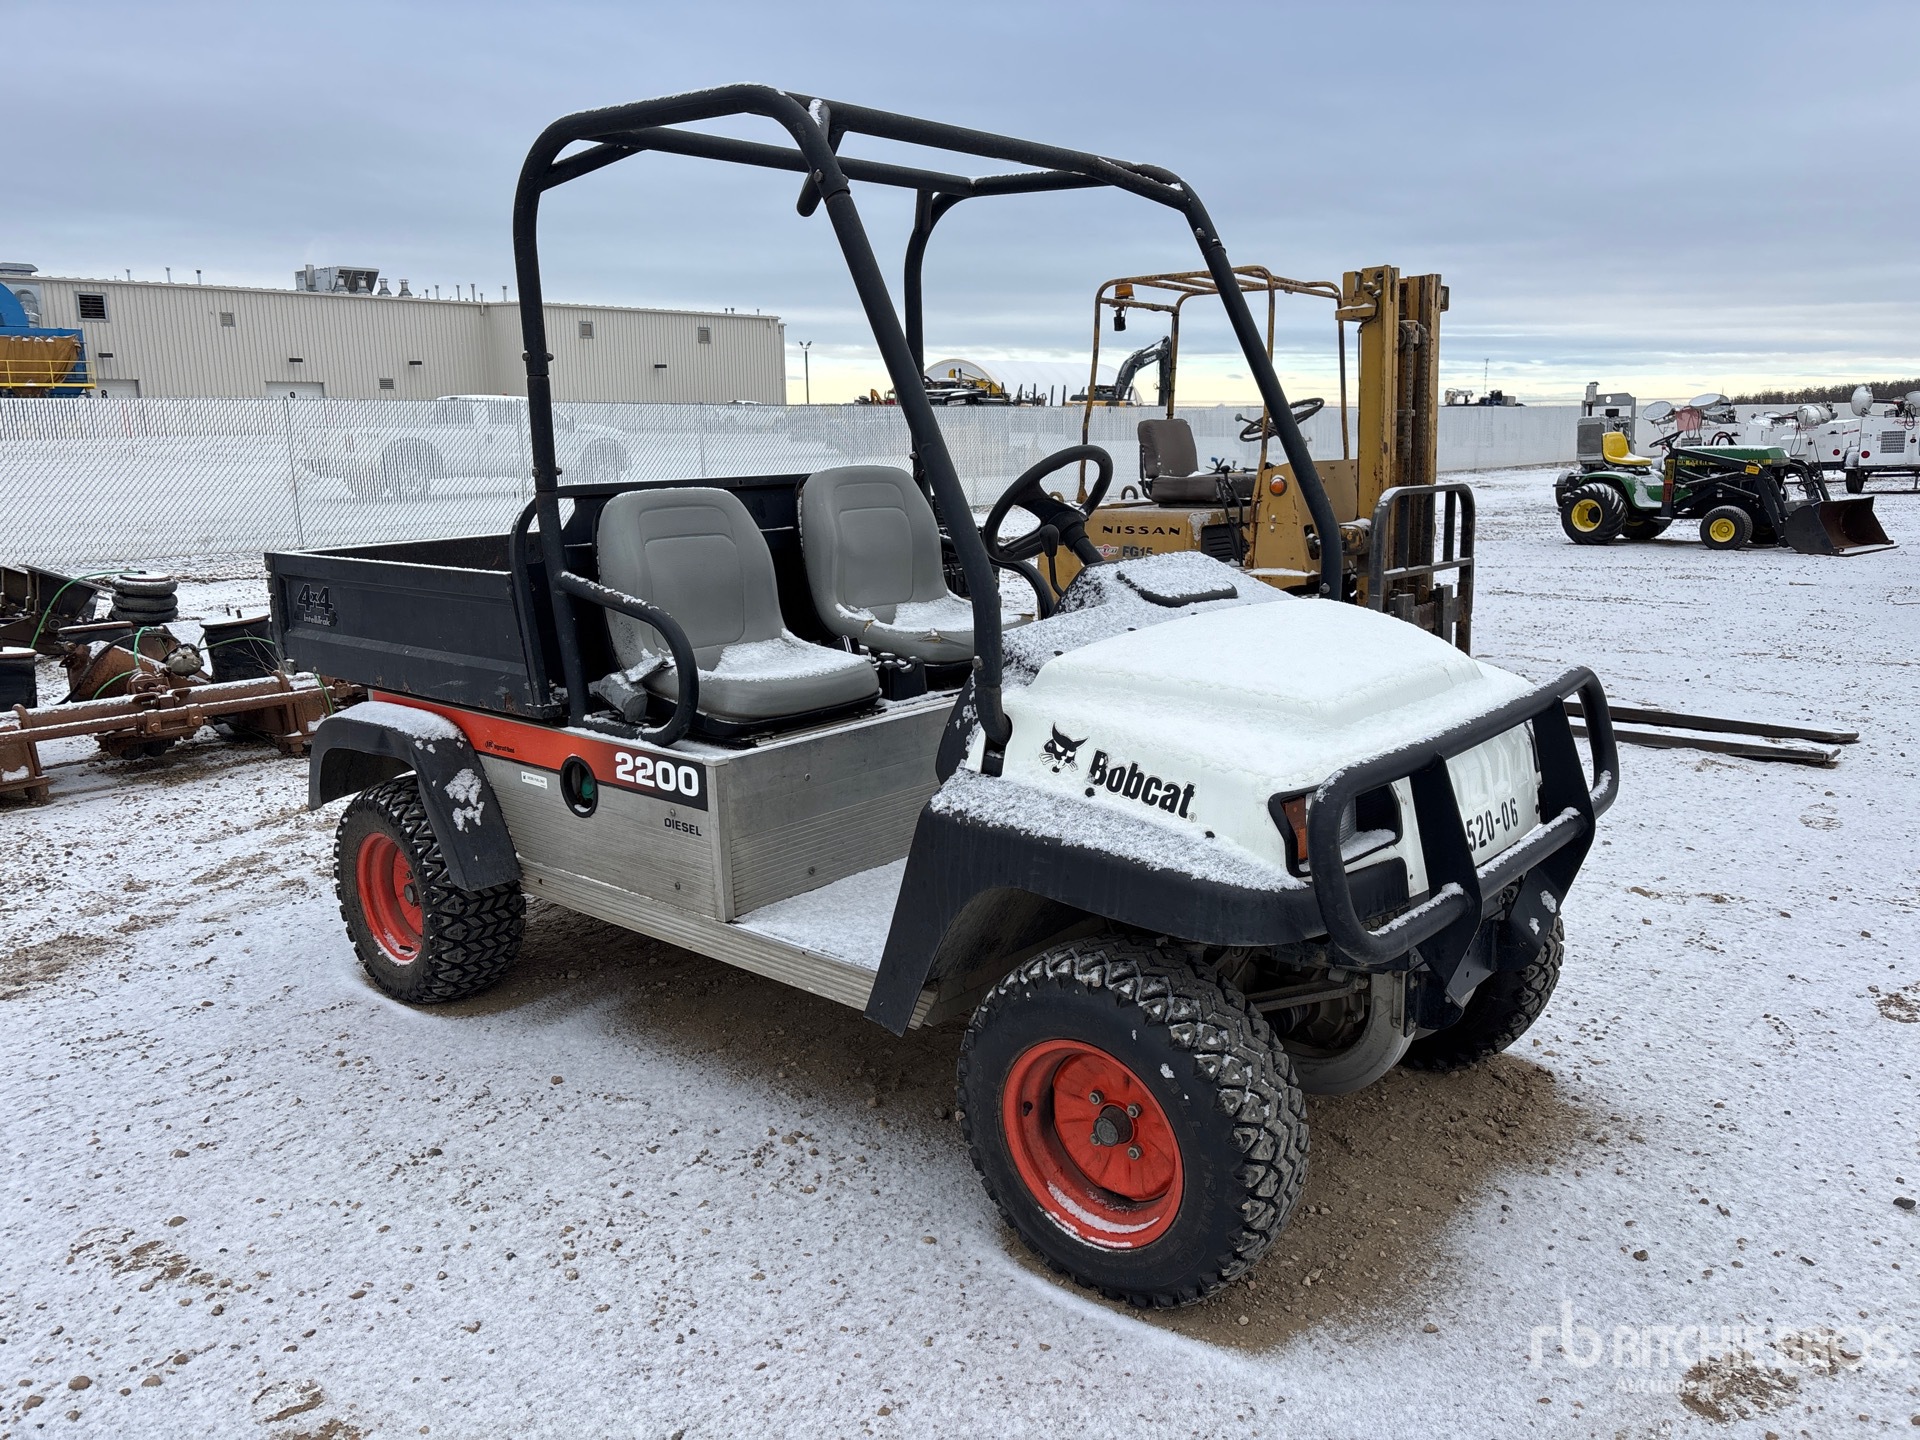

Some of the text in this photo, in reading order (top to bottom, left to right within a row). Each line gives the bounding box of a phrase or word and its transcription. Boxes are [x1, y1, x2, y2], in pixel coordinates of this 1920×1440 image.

[1102, 525, 1180, 536] NISSAN
[1122, 545, 1153, 557] FG15
[297, 583, 334, 616] 4x4
[615, 751, 699, 797] 2200
[1088, 749, 1196, 819] Bobcat
[664, 817, 702, 837] DIESEL
[1466, 797, 1519, 852] 520-06
